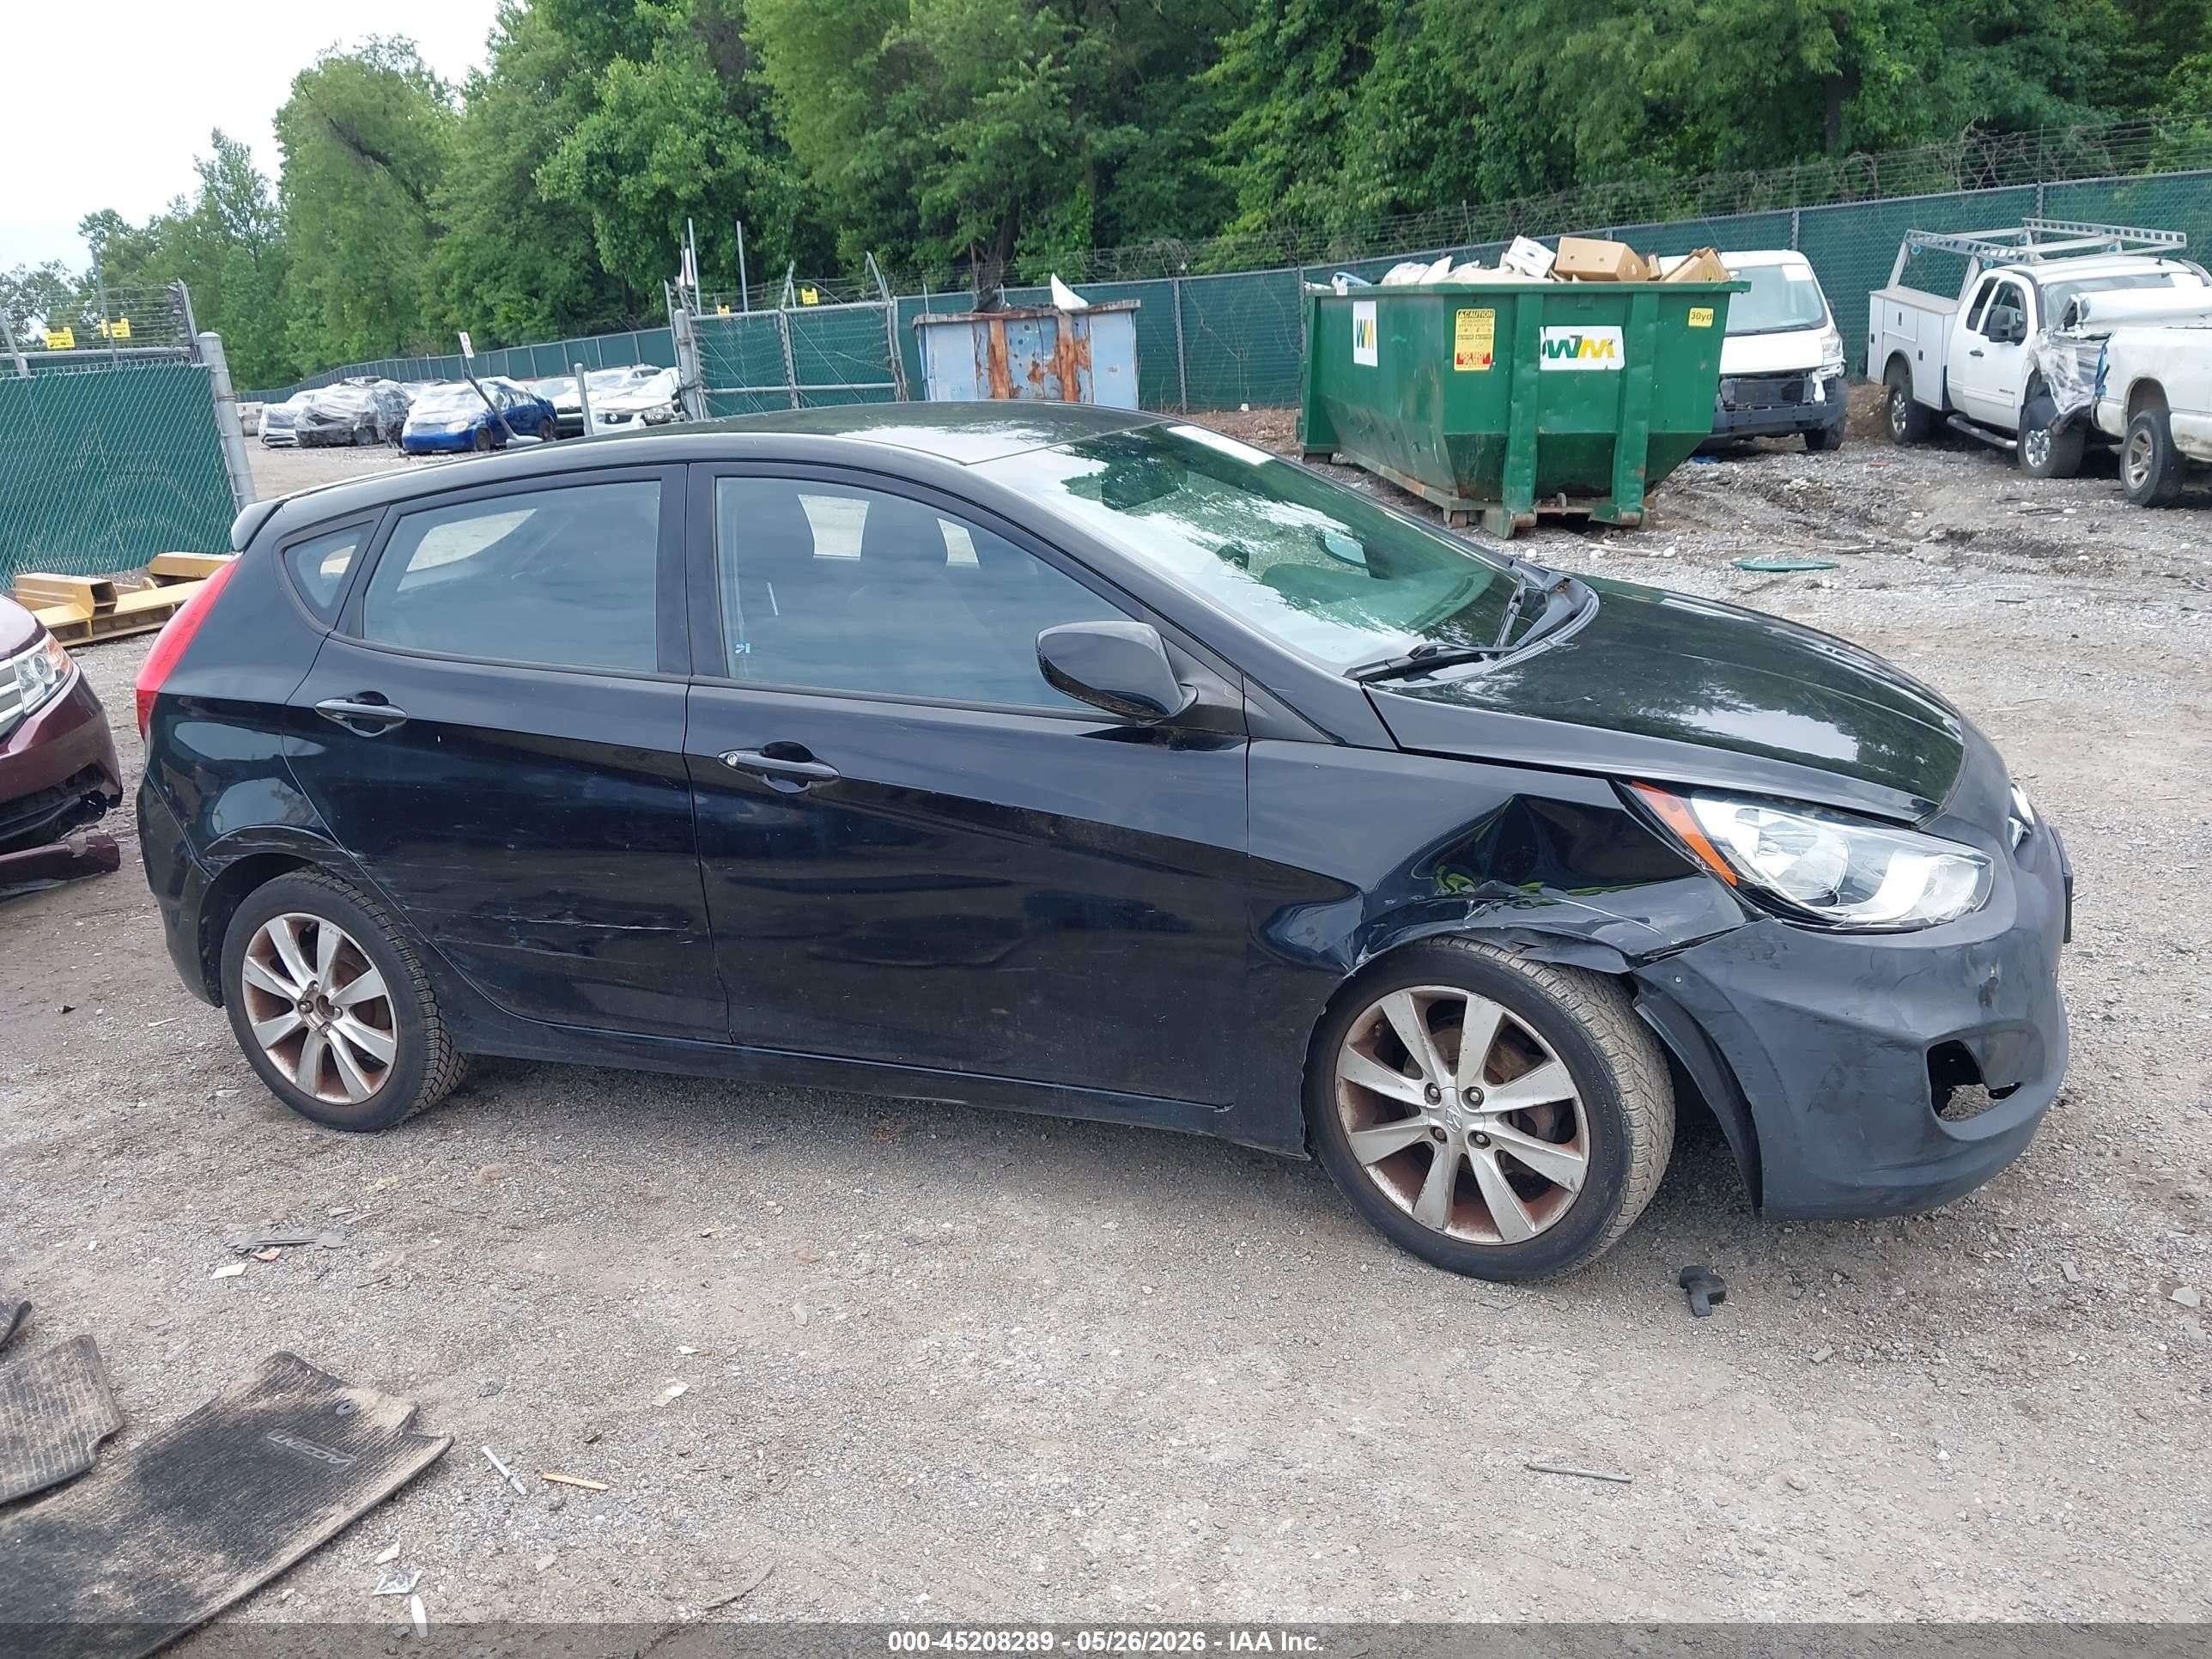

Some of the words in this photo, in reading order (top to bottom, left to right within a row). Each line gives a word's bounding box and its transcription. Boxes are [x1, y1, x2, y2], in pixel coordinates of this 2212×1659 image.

[1691, 311, 1712, 322] 30yd
[1356, 319, 1375, 350] WM
[1545, 337, 1615, 359] WM
